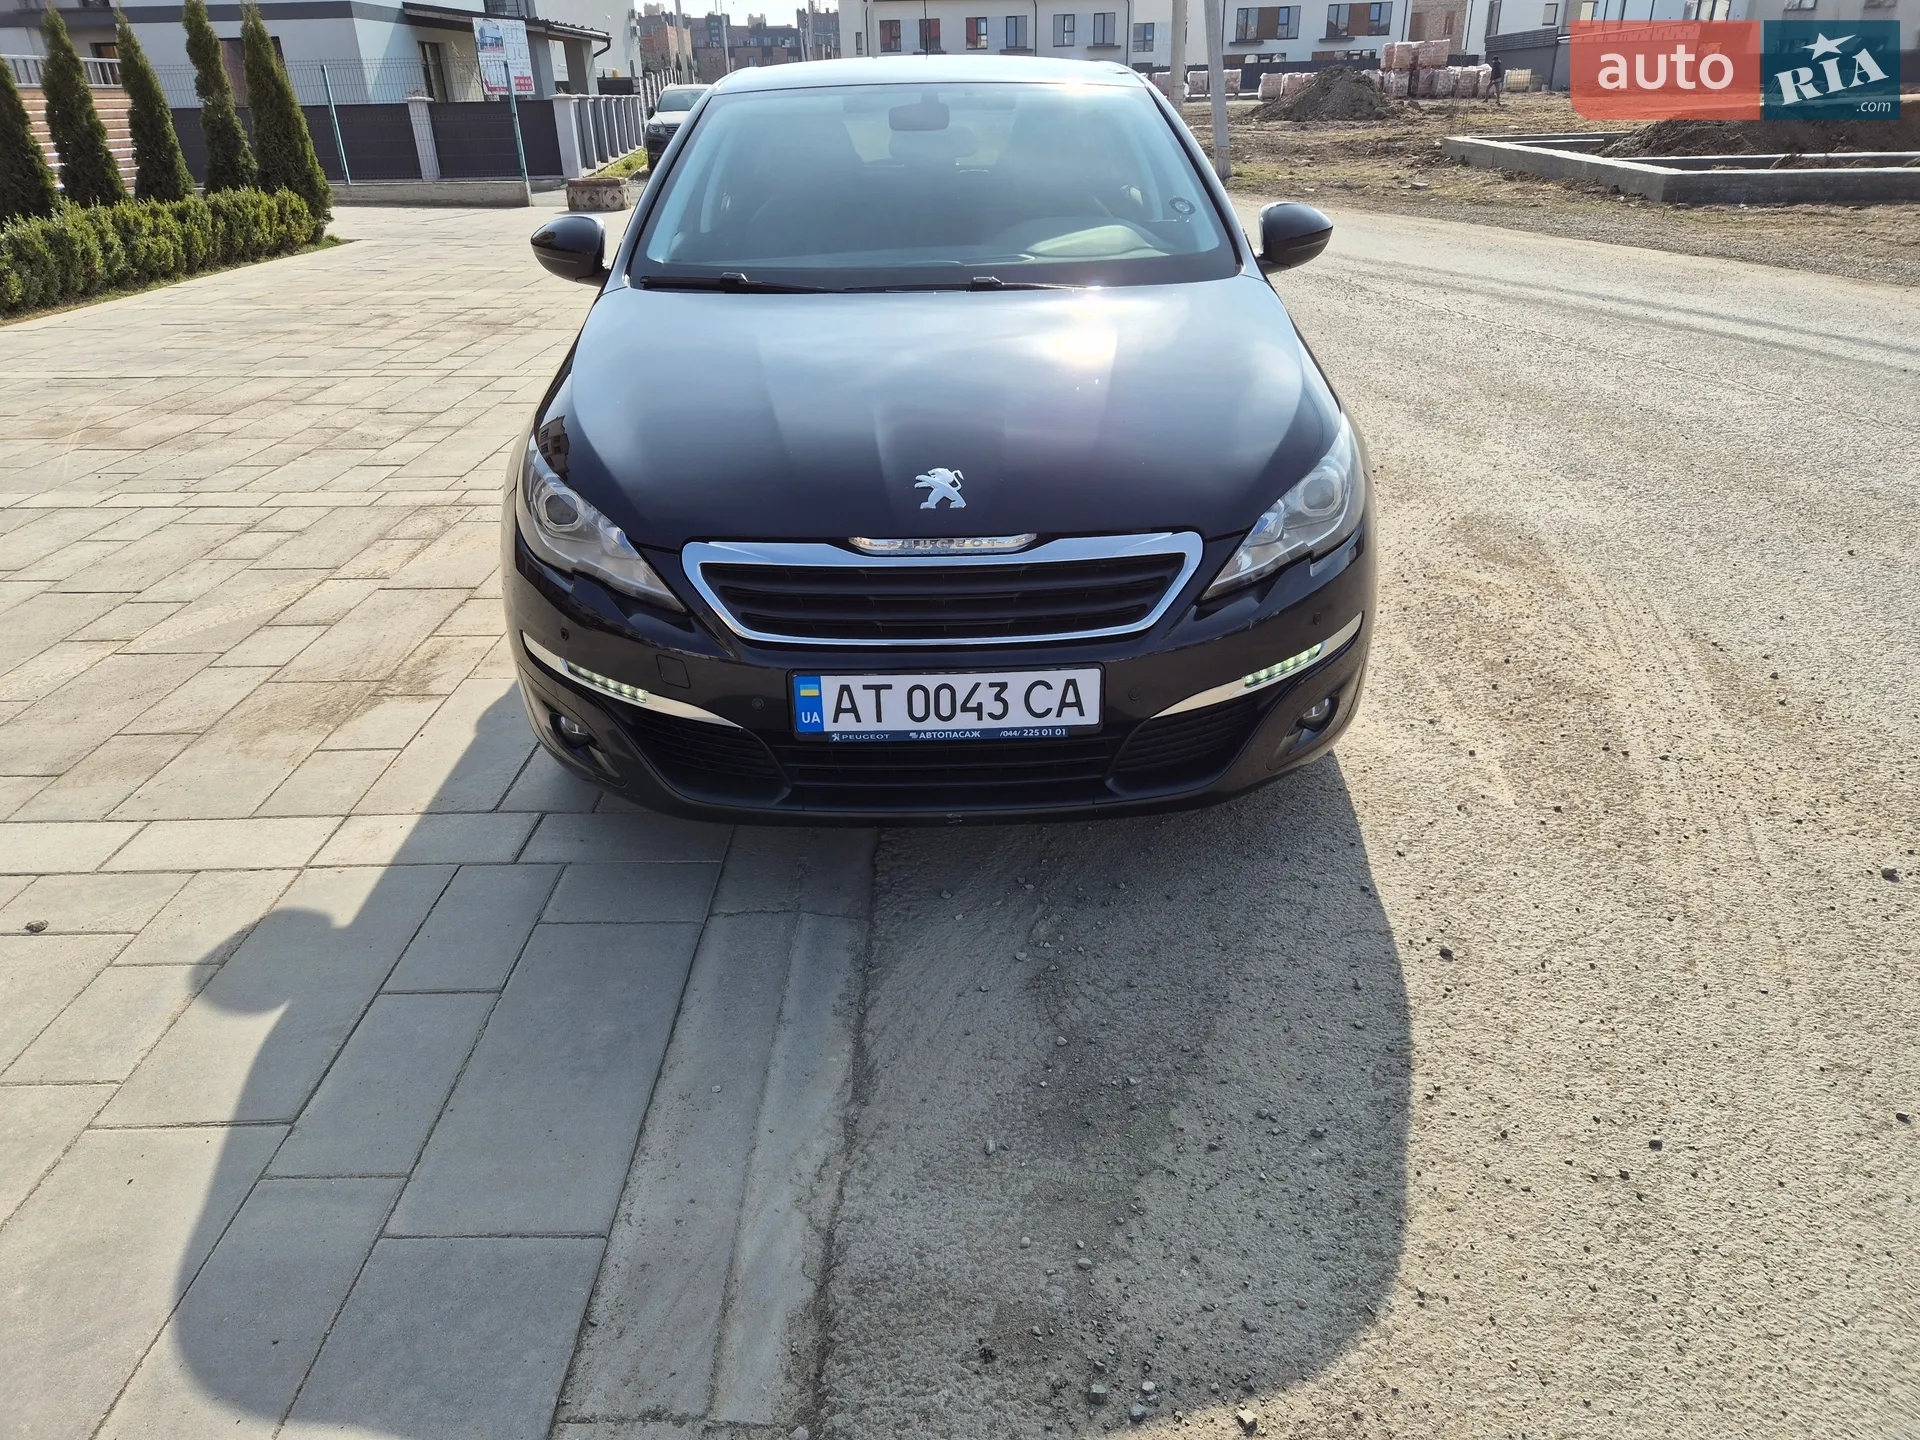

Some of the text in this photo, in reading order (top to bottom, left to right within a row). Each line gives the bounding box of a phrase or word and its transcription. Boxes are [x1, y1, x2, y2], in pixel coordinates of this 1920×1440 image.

[886, 538, 998, 549] PEUGEOT
[832, 678, 1085, 723] AT 0043 CA
[801, 712, 821, 724] UA
[919, 730, 981, 739] АВТОПАСАЖ
[1041, 728, 1052, 736] 01
[1055, 728, 1066, 736] 01
